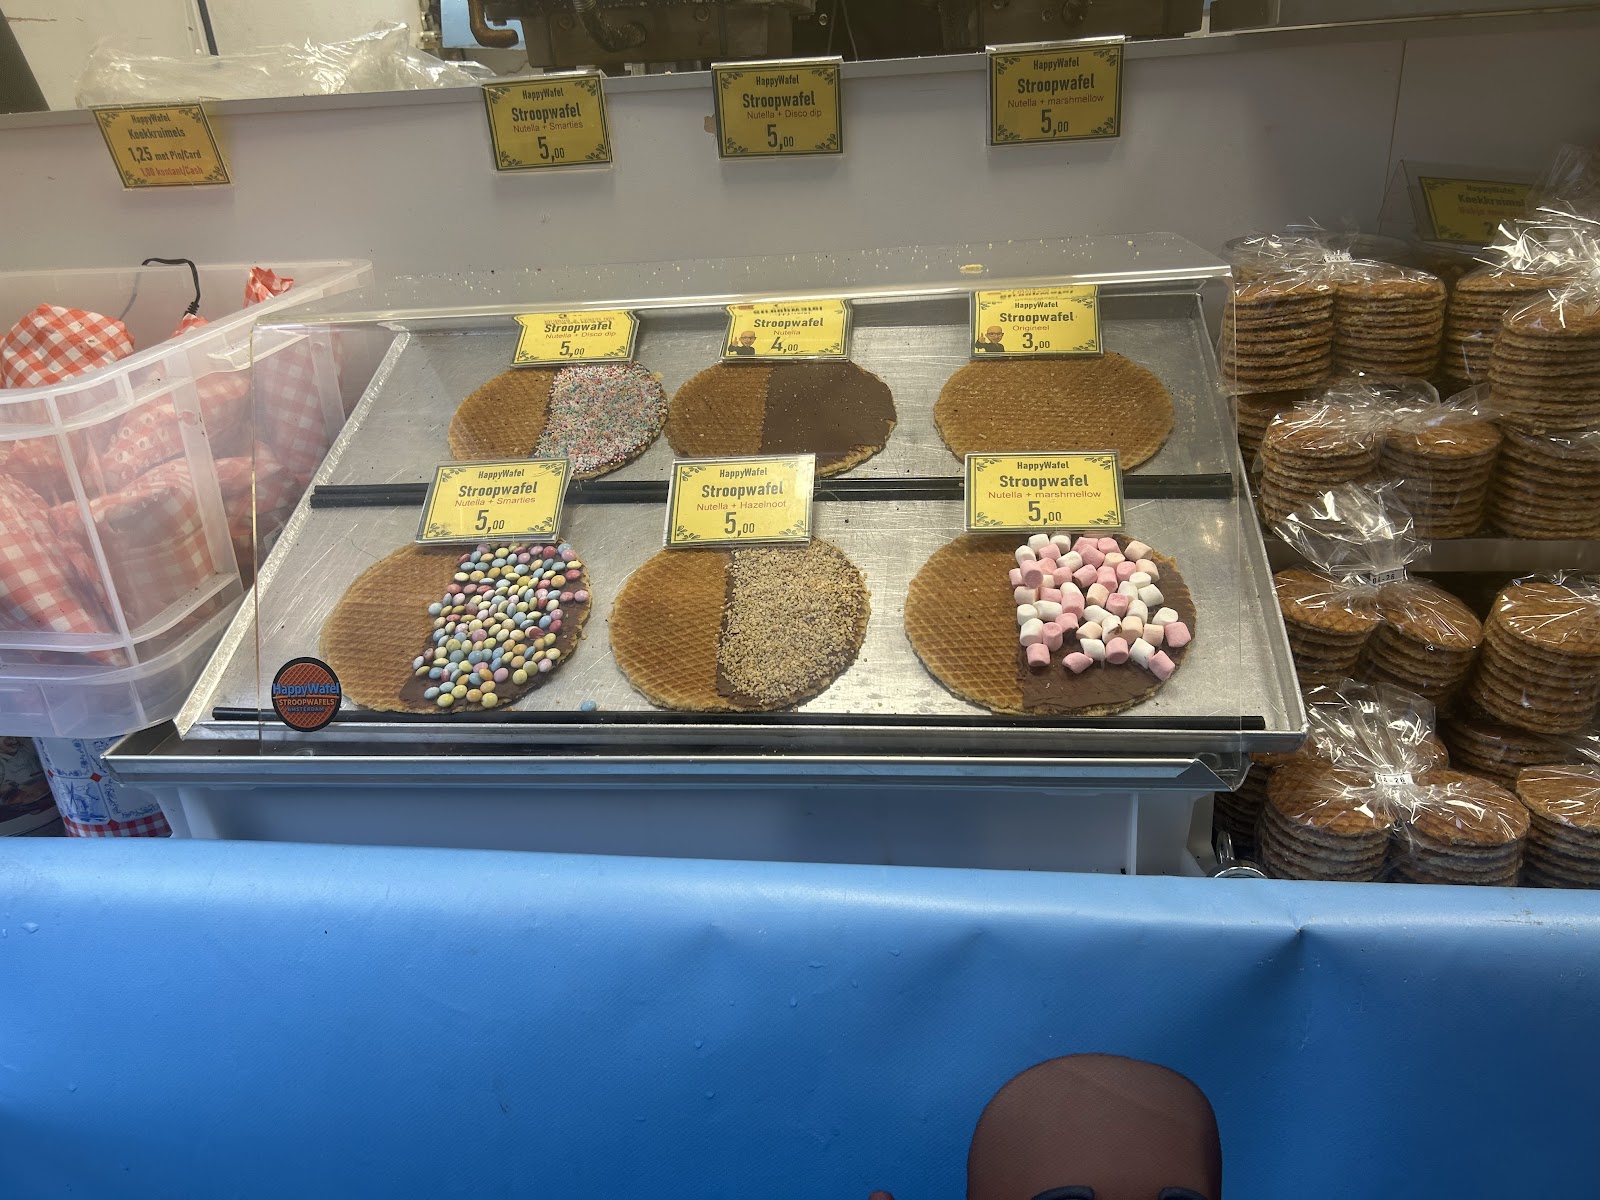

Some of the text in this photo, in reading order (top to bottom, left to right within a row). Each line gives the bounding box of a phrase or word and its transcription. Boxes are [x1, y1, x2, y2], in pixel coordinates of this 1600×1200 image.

[1033, 57, 1080, 71] HappyWafel
[755, 75, 800, 88] HappyWafel
[1017, 73, 1095, 95] Stroopwafel
[522, 88, 564, 101] HappyWafel
[742, 90, 816, 111] Stroopwafel
[1007, 98, 1037, 108] Nutella
[1047, 94, 1105, 106] marshmellow
[131, 113, 171, 125] HappyWafel
[511, 102, 581, 123] Stroopwafel
[747, 111, 775, 120] Nutella
[785, 109, 808, 119] Disco
[810, 108, 822, 120] dip
[513, 123, 540, 133] Nutella
[549, 121, 584, 131] Smarties
[1041, 109, 1069, 137] 5,00
[767, 124, 794, 152] 5,00
[128, 147, 202, 164] 1,25 met Pin/Card
[537, 136, 565, 163] 5,00
[1014, 301, 1058, 309] HappyWafel
[753, 317, 824, 329] Stroopwafel
[999, 311, 1074, 324] Stroopwafel
[544, 321, 612, 333] Stroopwafel
[771, 336, 798, 354] 4,00
[1022, 332, 1050, 351] 3,00
[559, 340, 585, 358] 5,00
[719, 467, 768, 479] HappyWafel
[1017, 461, 1070, 471] HappyWafel
[478, 469, 525, 480] HappyWafel
[999, 474, 1089, 490] Stroopwafel
[458, 481, 538, 499] Stroopwafel
[701, 481, 783, 500] Stroopwafel
[988, 491, 1023, 499] Nutella
[454, 499, 485, 507] Nutella
[496, 497, 536, 505] Smarties
[696, 502, 729, 511] Nutella
[740, 500, 787, 509] Hazelnoot
[1028, 500, 1062, 525] 5,00
[474, 509, 505, 534] 5,00
[724, 511, 755, 537] 5,00
[272, 682, 340, 697] HappyWafel
[279, 698, 335, 706] STROOPWAFELS
